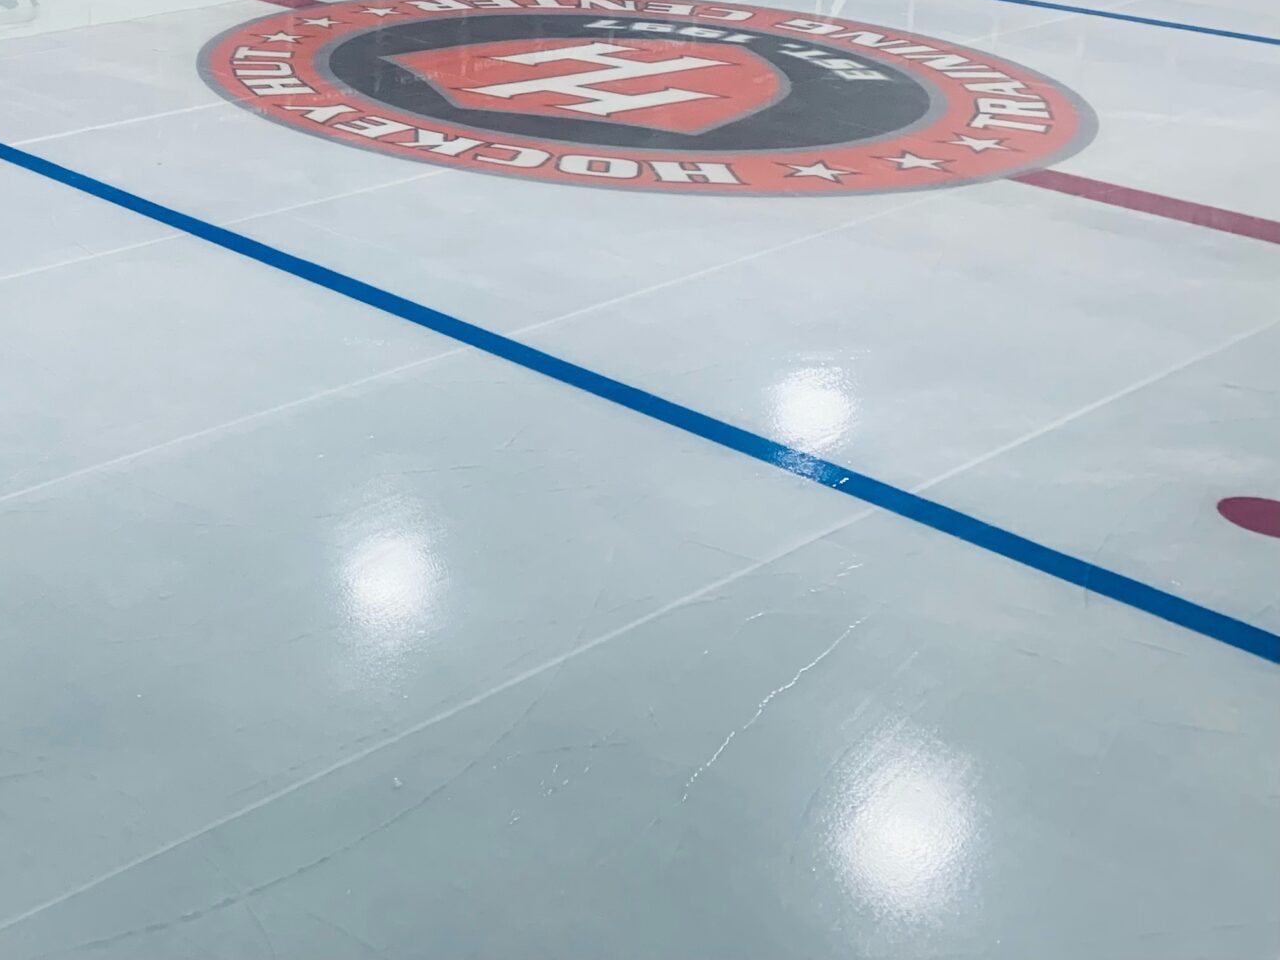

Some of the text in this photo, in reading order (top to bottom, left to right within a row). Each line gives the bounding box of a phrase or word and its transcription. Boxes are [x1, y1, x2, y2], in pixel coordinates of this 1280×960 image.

[233, 46, 315, 96] HUT
[584, 19, 892, 81] EST. 1997
[779, 19, 1052, 133] TRAINING
[282, 104, 745, 185] HOCKEY
